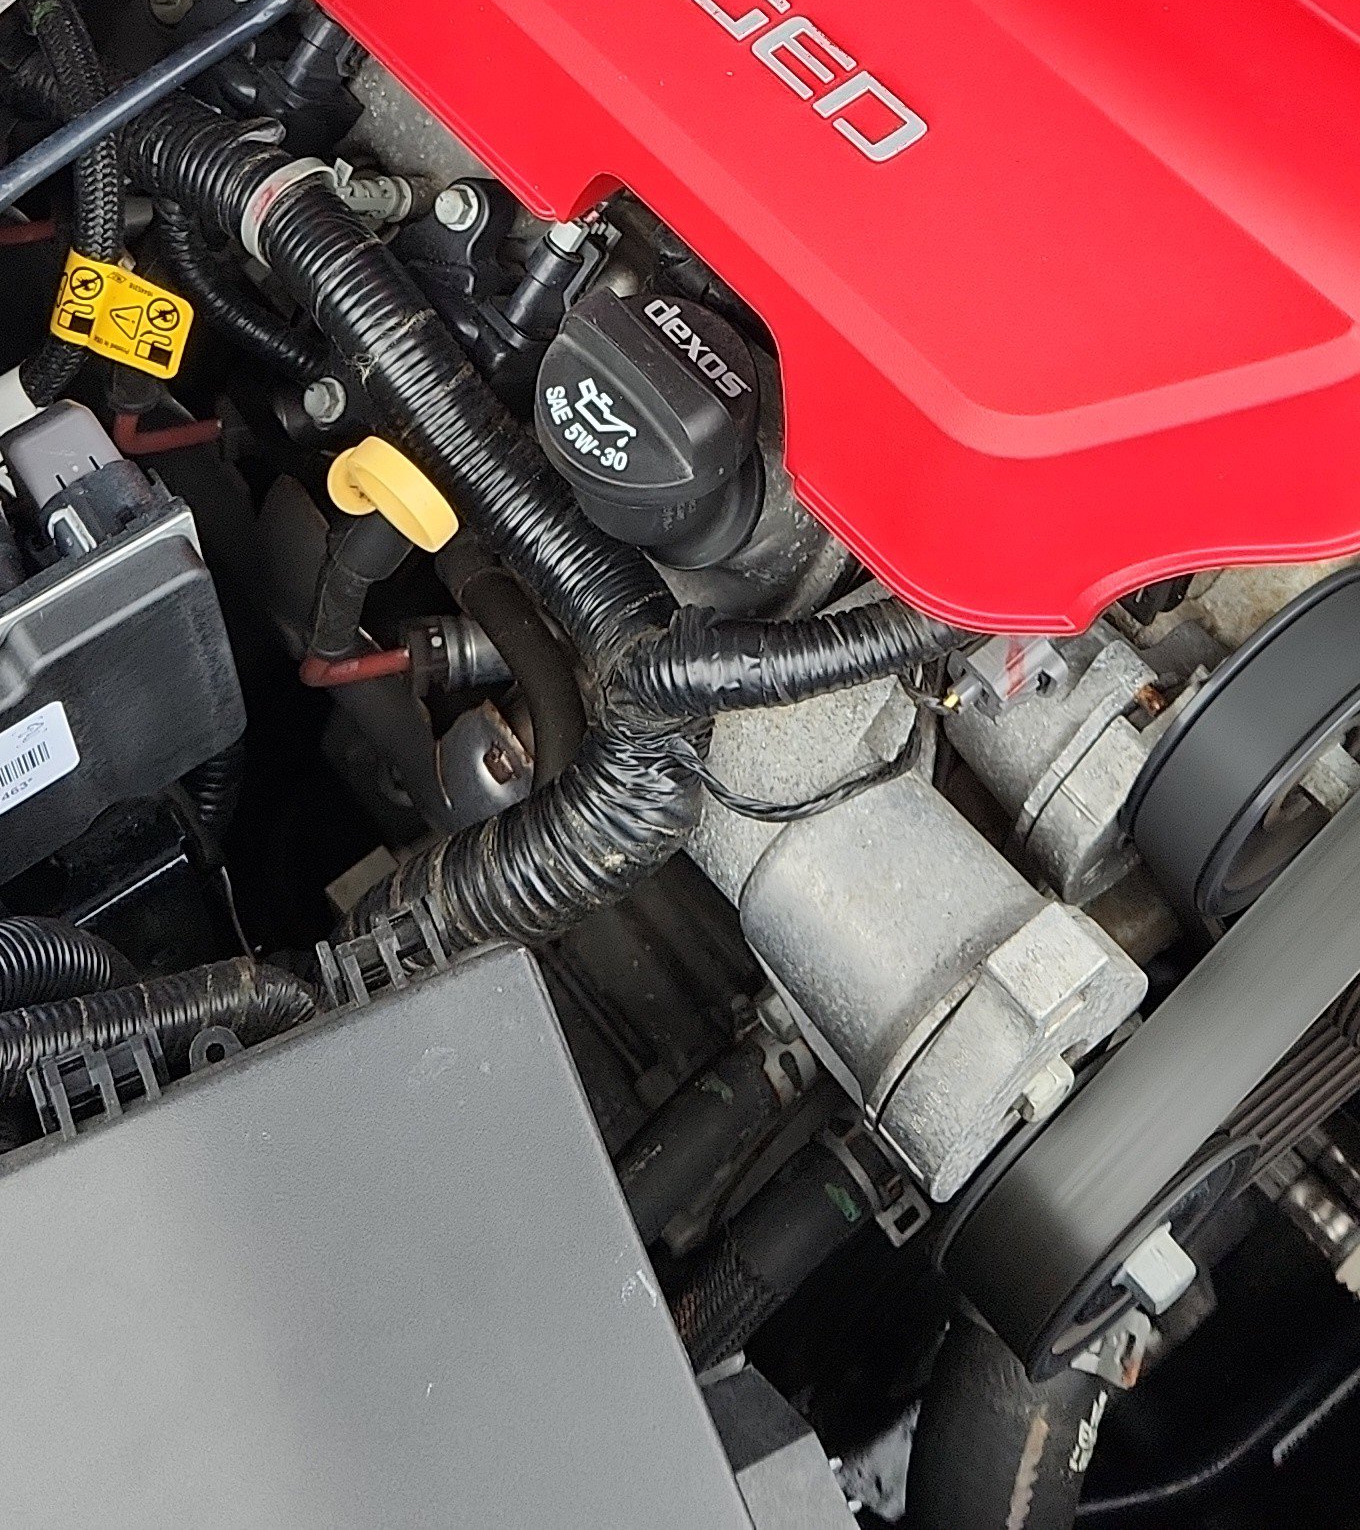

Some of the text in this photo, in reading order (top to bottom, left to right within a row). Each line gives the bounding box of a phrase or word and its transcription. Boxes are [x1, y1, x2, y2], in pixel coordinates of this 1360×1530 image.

[644, 299, 745, 397] dexos
[546, 386, 628, 471] SAE 5W-30
